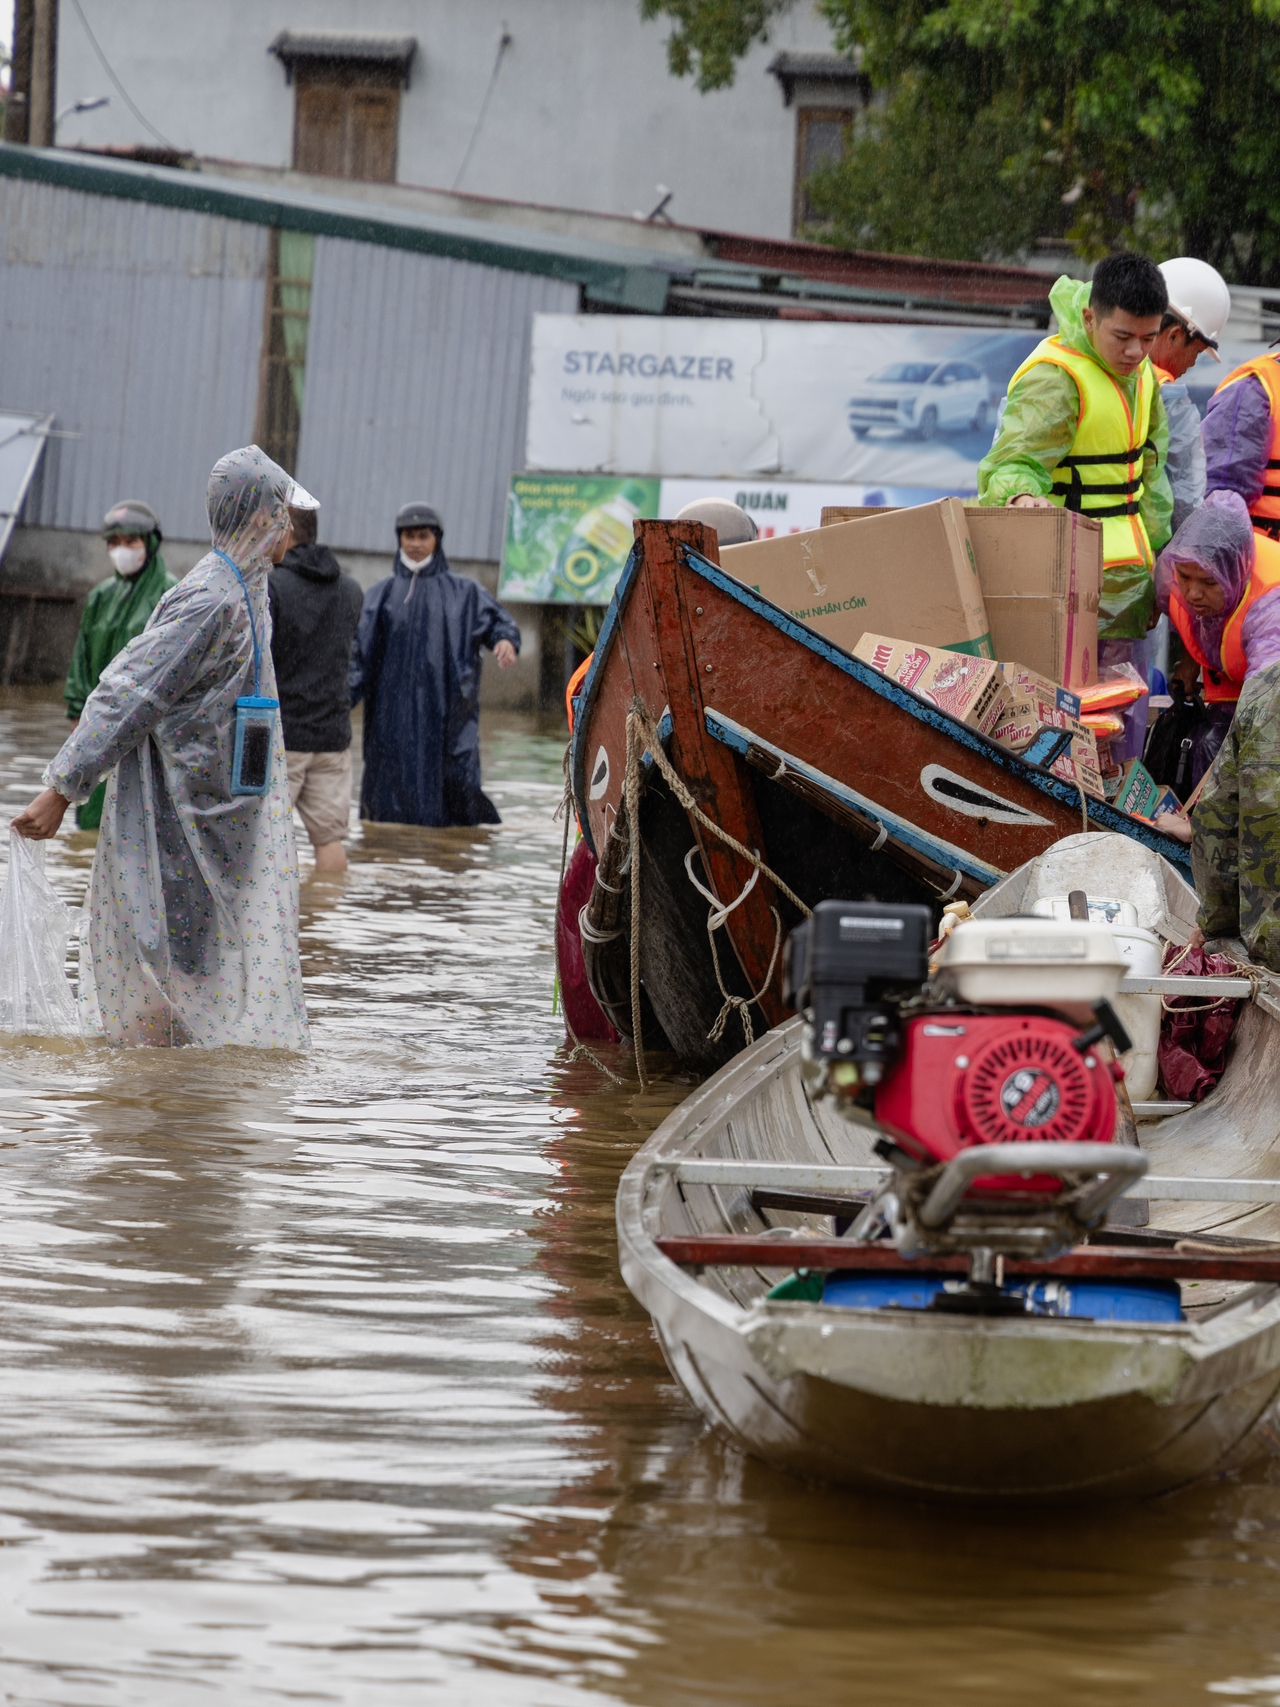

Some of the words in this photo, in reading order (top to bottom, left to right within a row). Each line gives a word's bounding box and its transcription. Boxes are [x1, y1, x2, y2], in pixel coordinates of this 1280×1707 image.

[563, 350, 734, 381] STARGAZER
[736, 488, 788, 511] QUÁN
[787, 609, 810, 620] ÁNH
